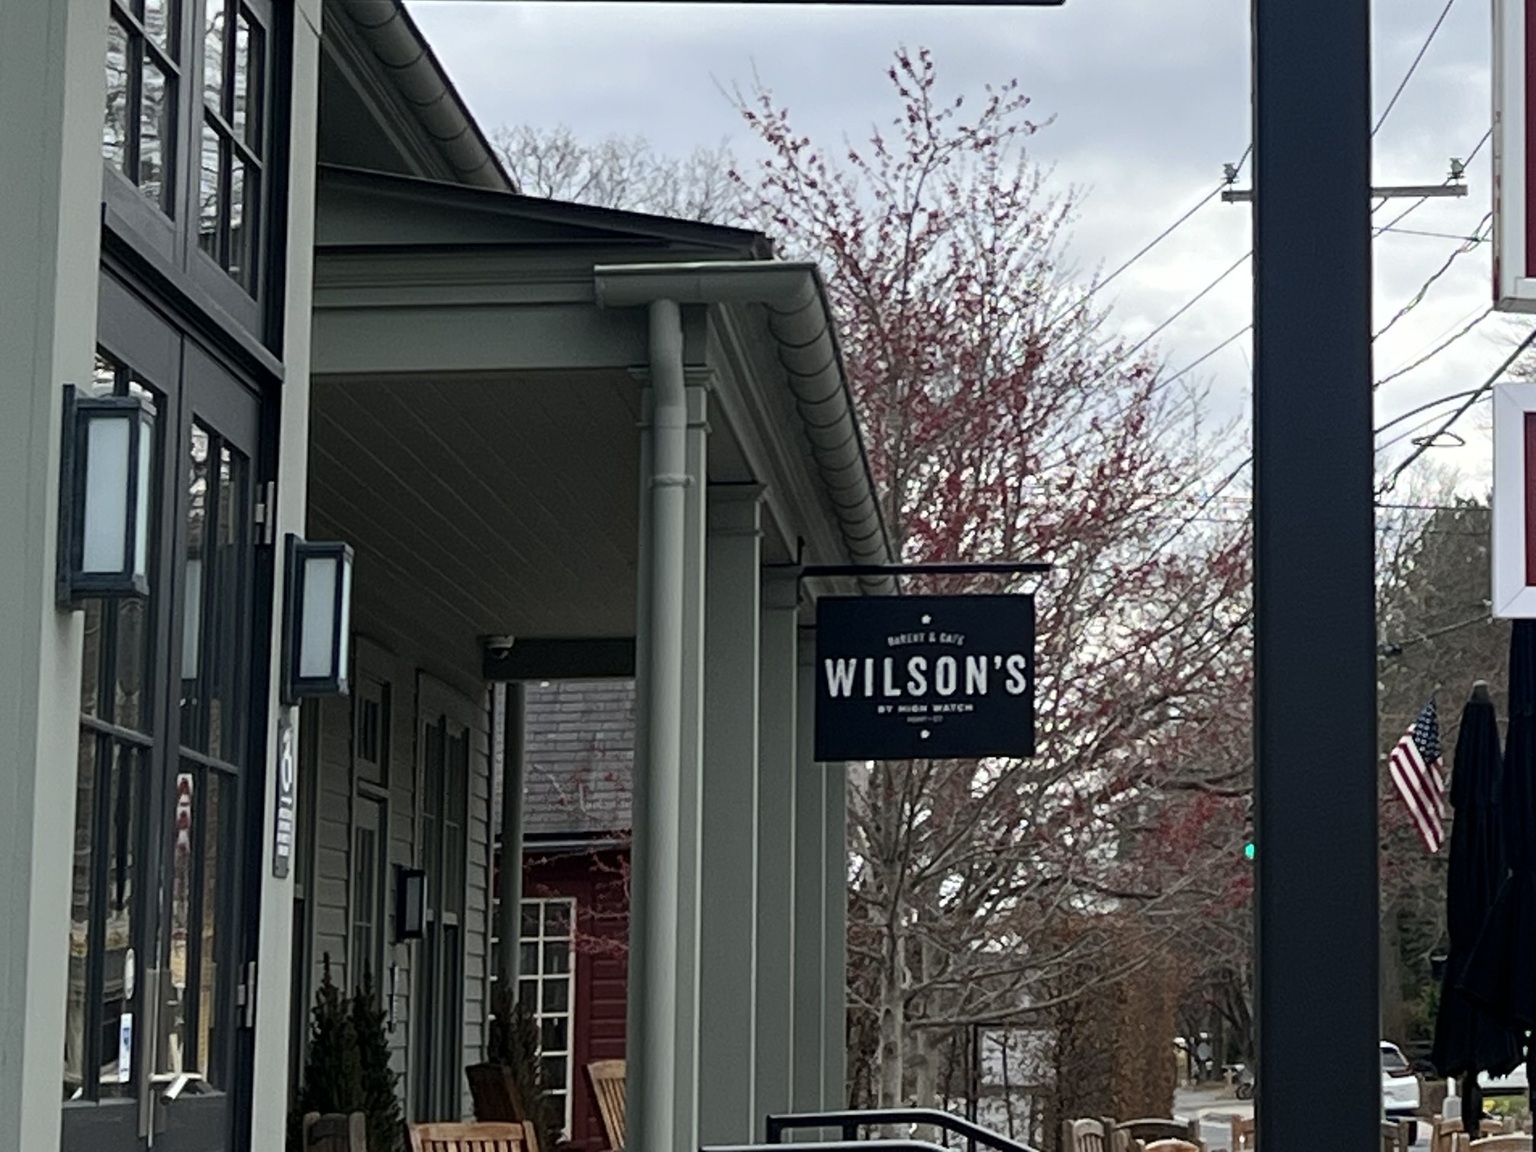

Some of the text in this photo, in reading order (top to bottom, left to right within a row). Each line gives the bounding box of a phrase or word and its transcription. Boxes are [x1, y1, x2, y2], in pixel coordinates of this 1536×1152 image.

[887, 632, 925, 647] BAKERY
[928, 632, 937, 643] &
[824, 655, 1027, 697] WILSON'S
[877, 703, 974, 714] BY HIGH WATCH
